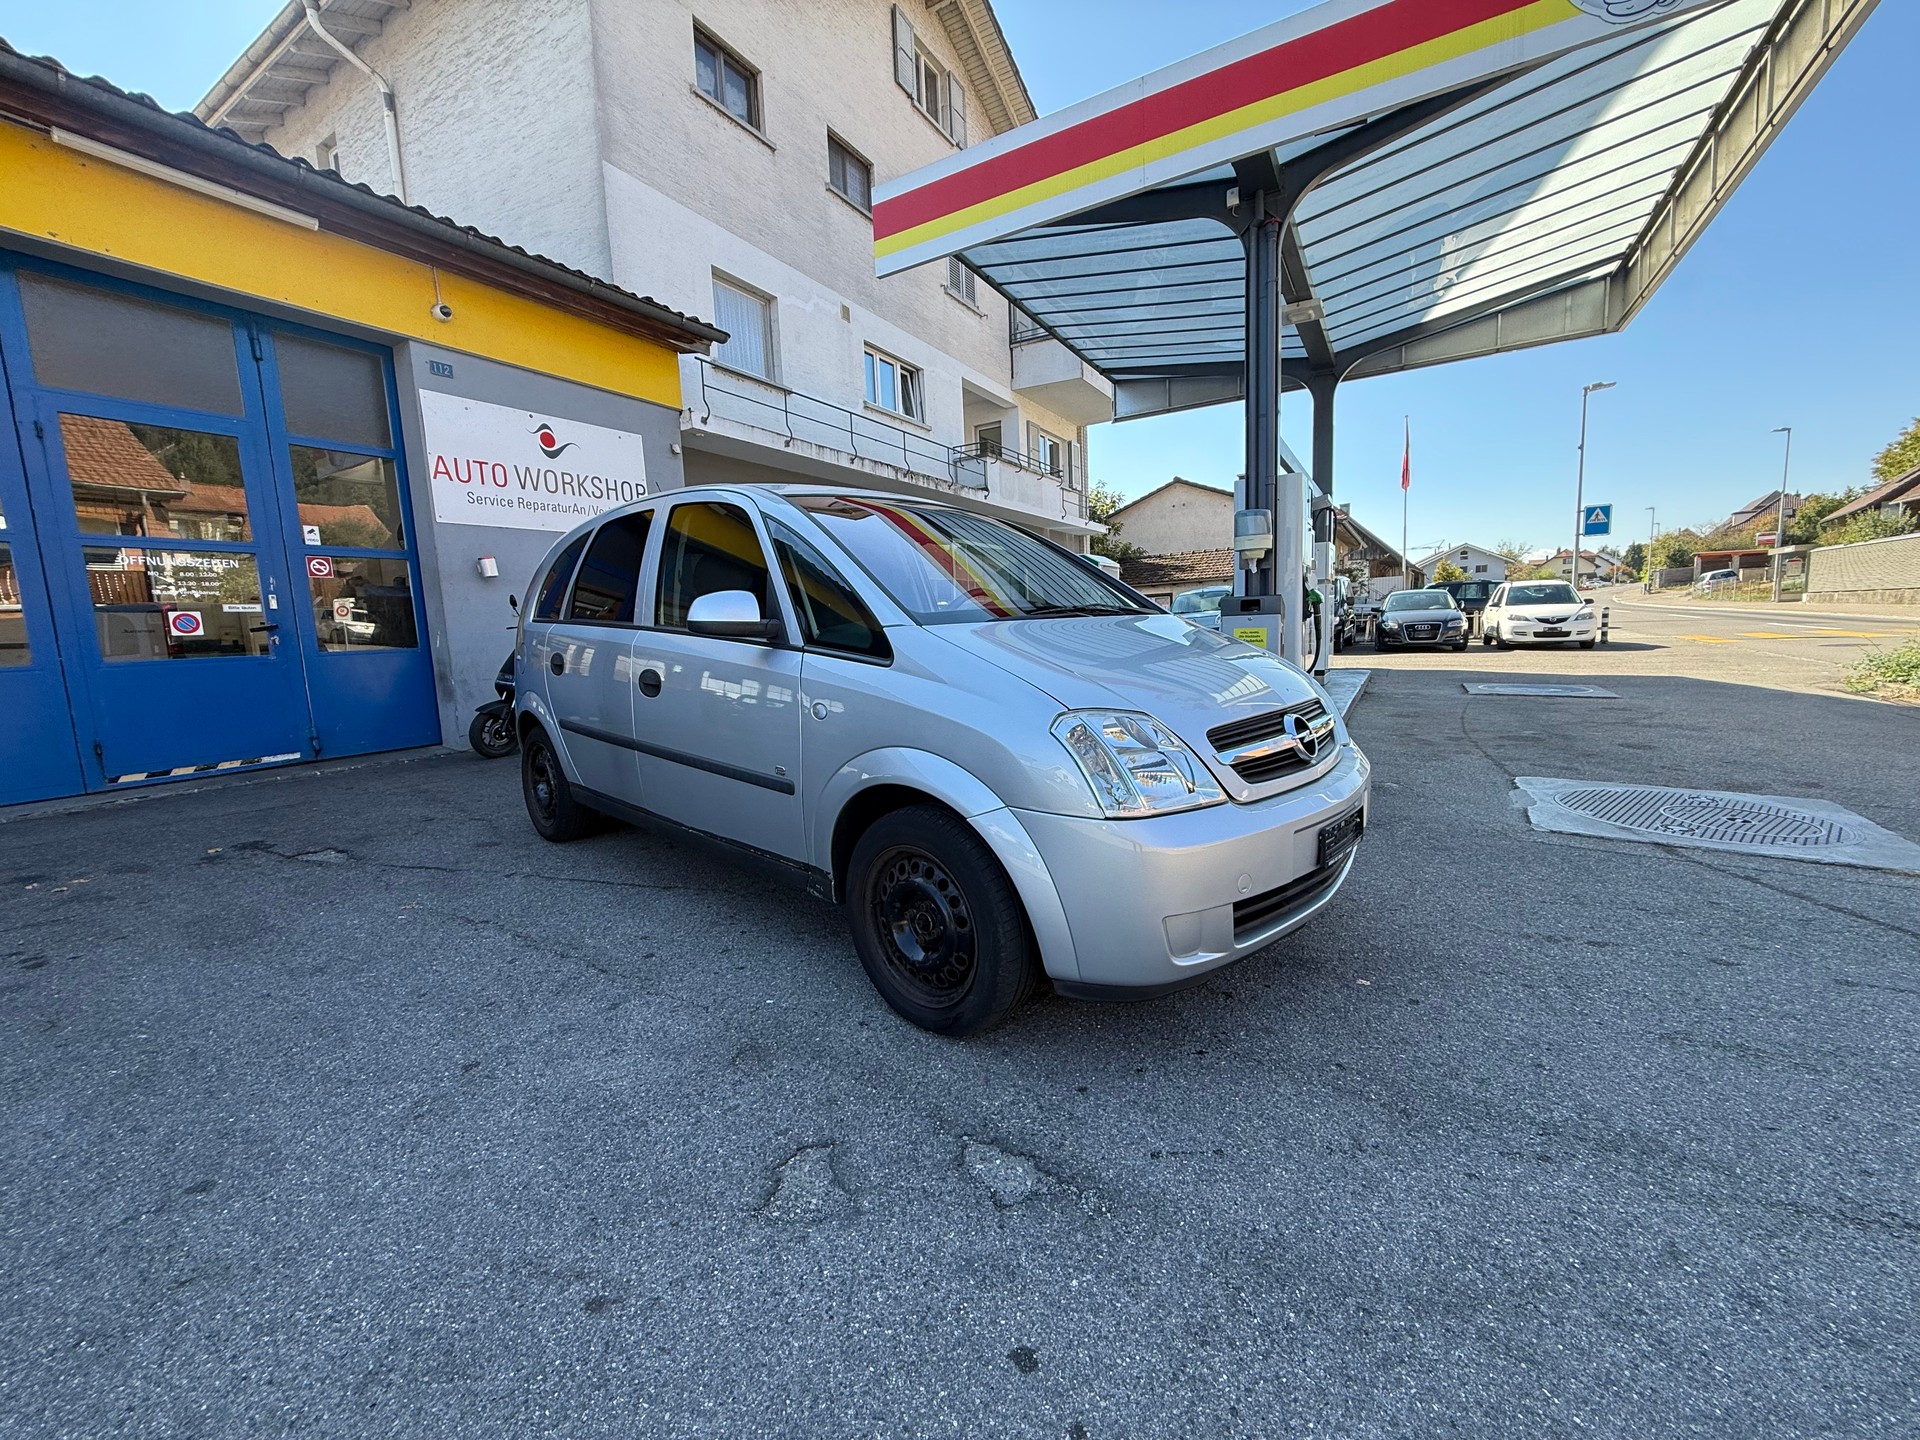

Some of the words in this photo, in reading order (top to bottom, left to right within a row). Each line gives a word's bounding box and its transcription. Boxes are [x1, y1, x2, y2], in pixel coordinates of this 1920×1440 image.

[431, 363, 451, 376] 112
[432, 455, 509, 488] AUTO
[513, 464, 647, 503] WORKSHOP
[466, 491, 514, 508] Service
[517, 495, 611, 517] ReparaturAn/Ve
